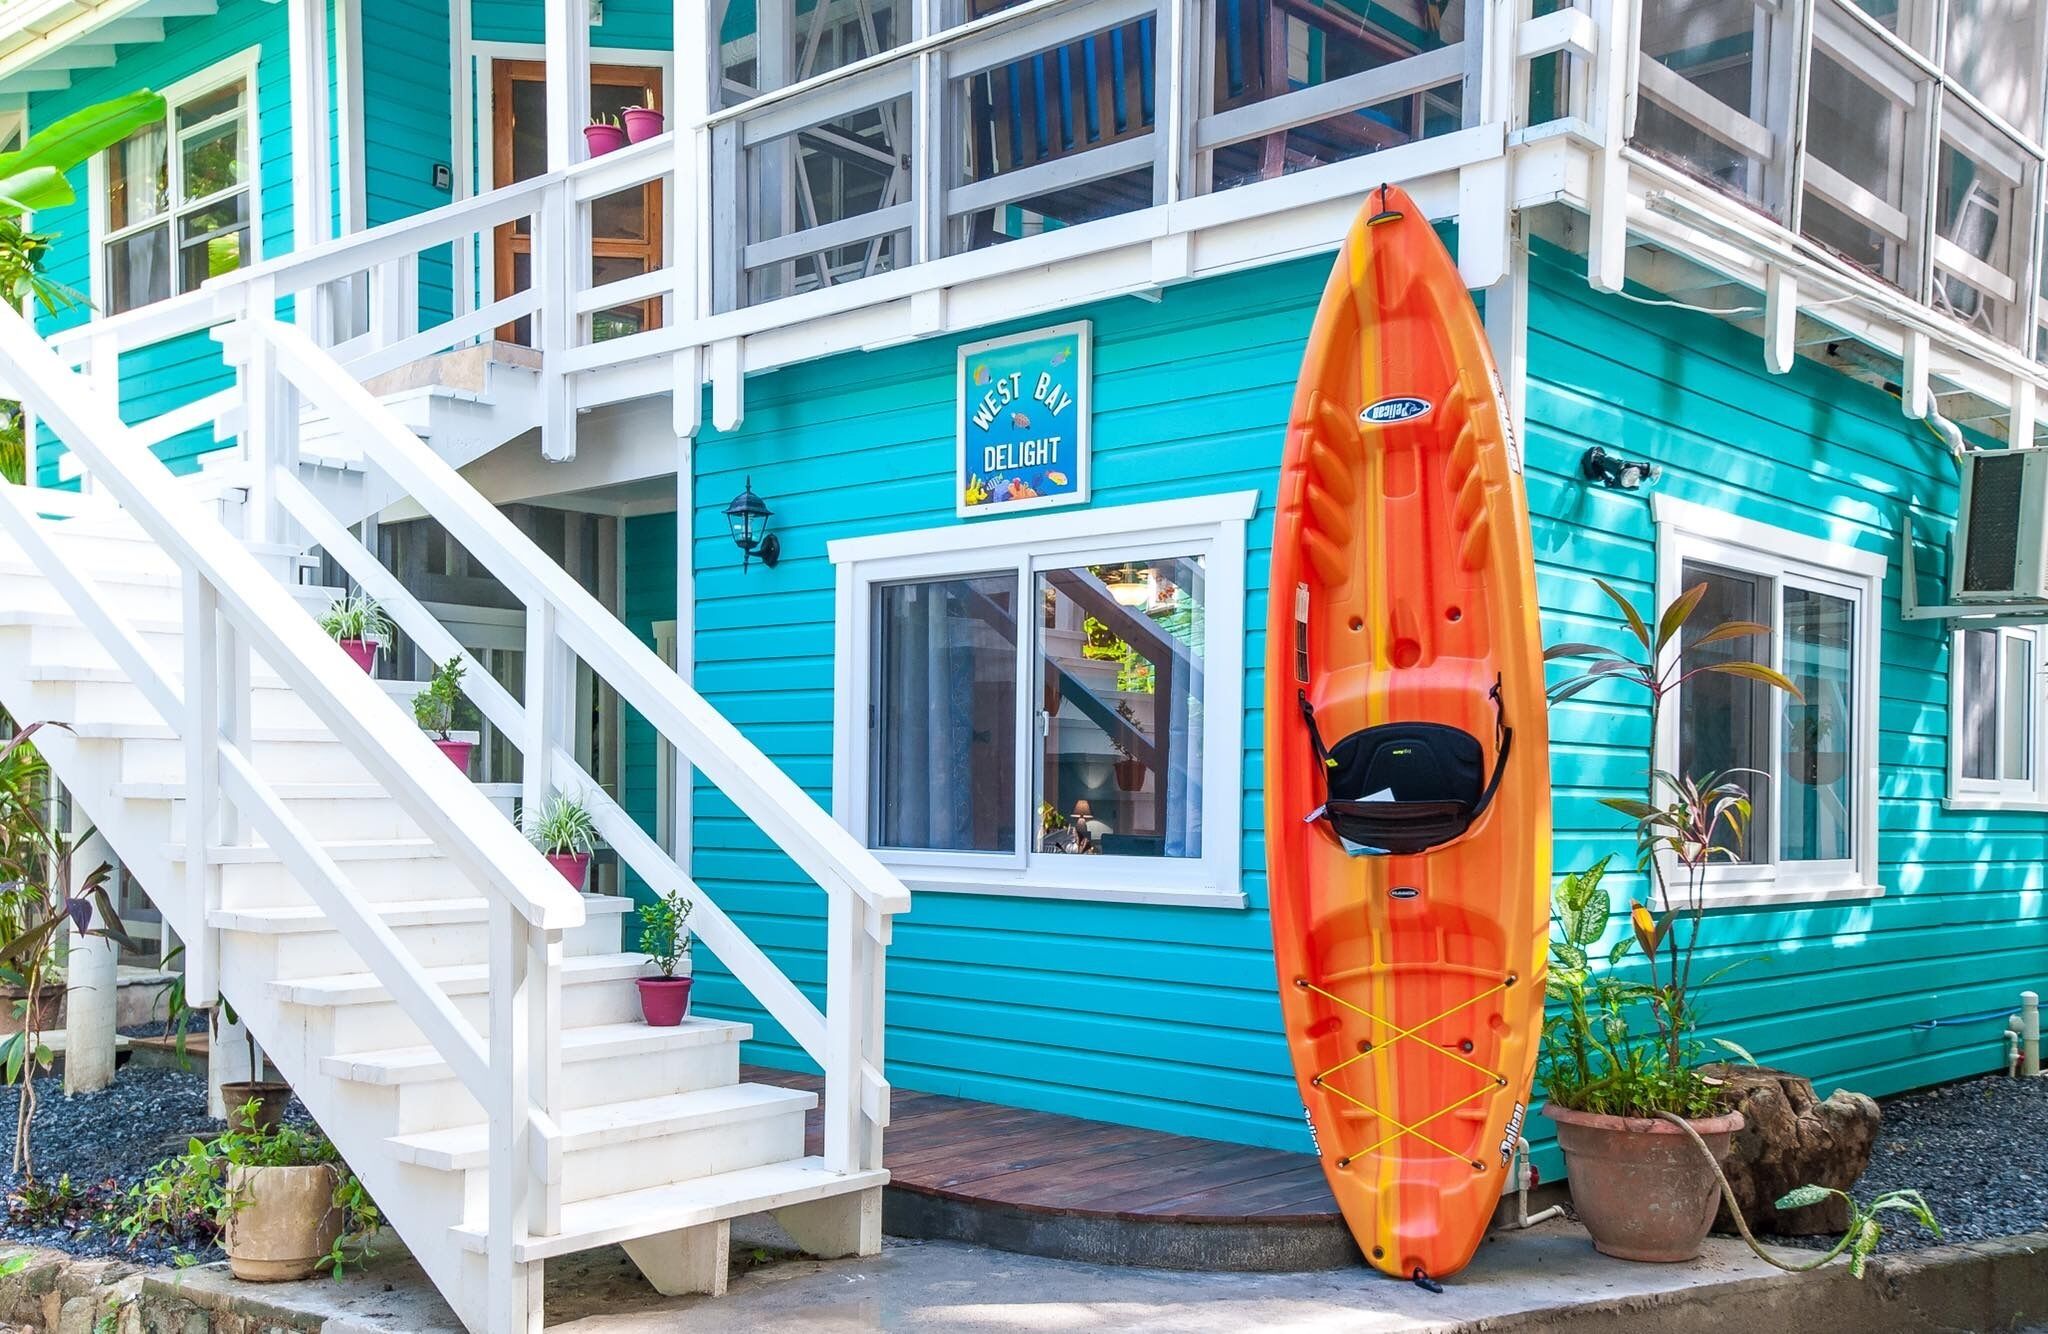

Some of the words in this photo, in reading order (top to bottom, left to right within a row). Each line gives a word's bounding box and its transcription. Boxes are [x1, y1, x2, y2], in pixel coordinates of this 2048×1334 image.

[973, 372, 1022, 431] WEST
[1034, 371, 1072, 416] BAY
[1372, 403, 1409, 419] Pelican
[984, 437, 1061, 473] DELIGHT
[1500, 1102, 1524, 1155] Pelican
